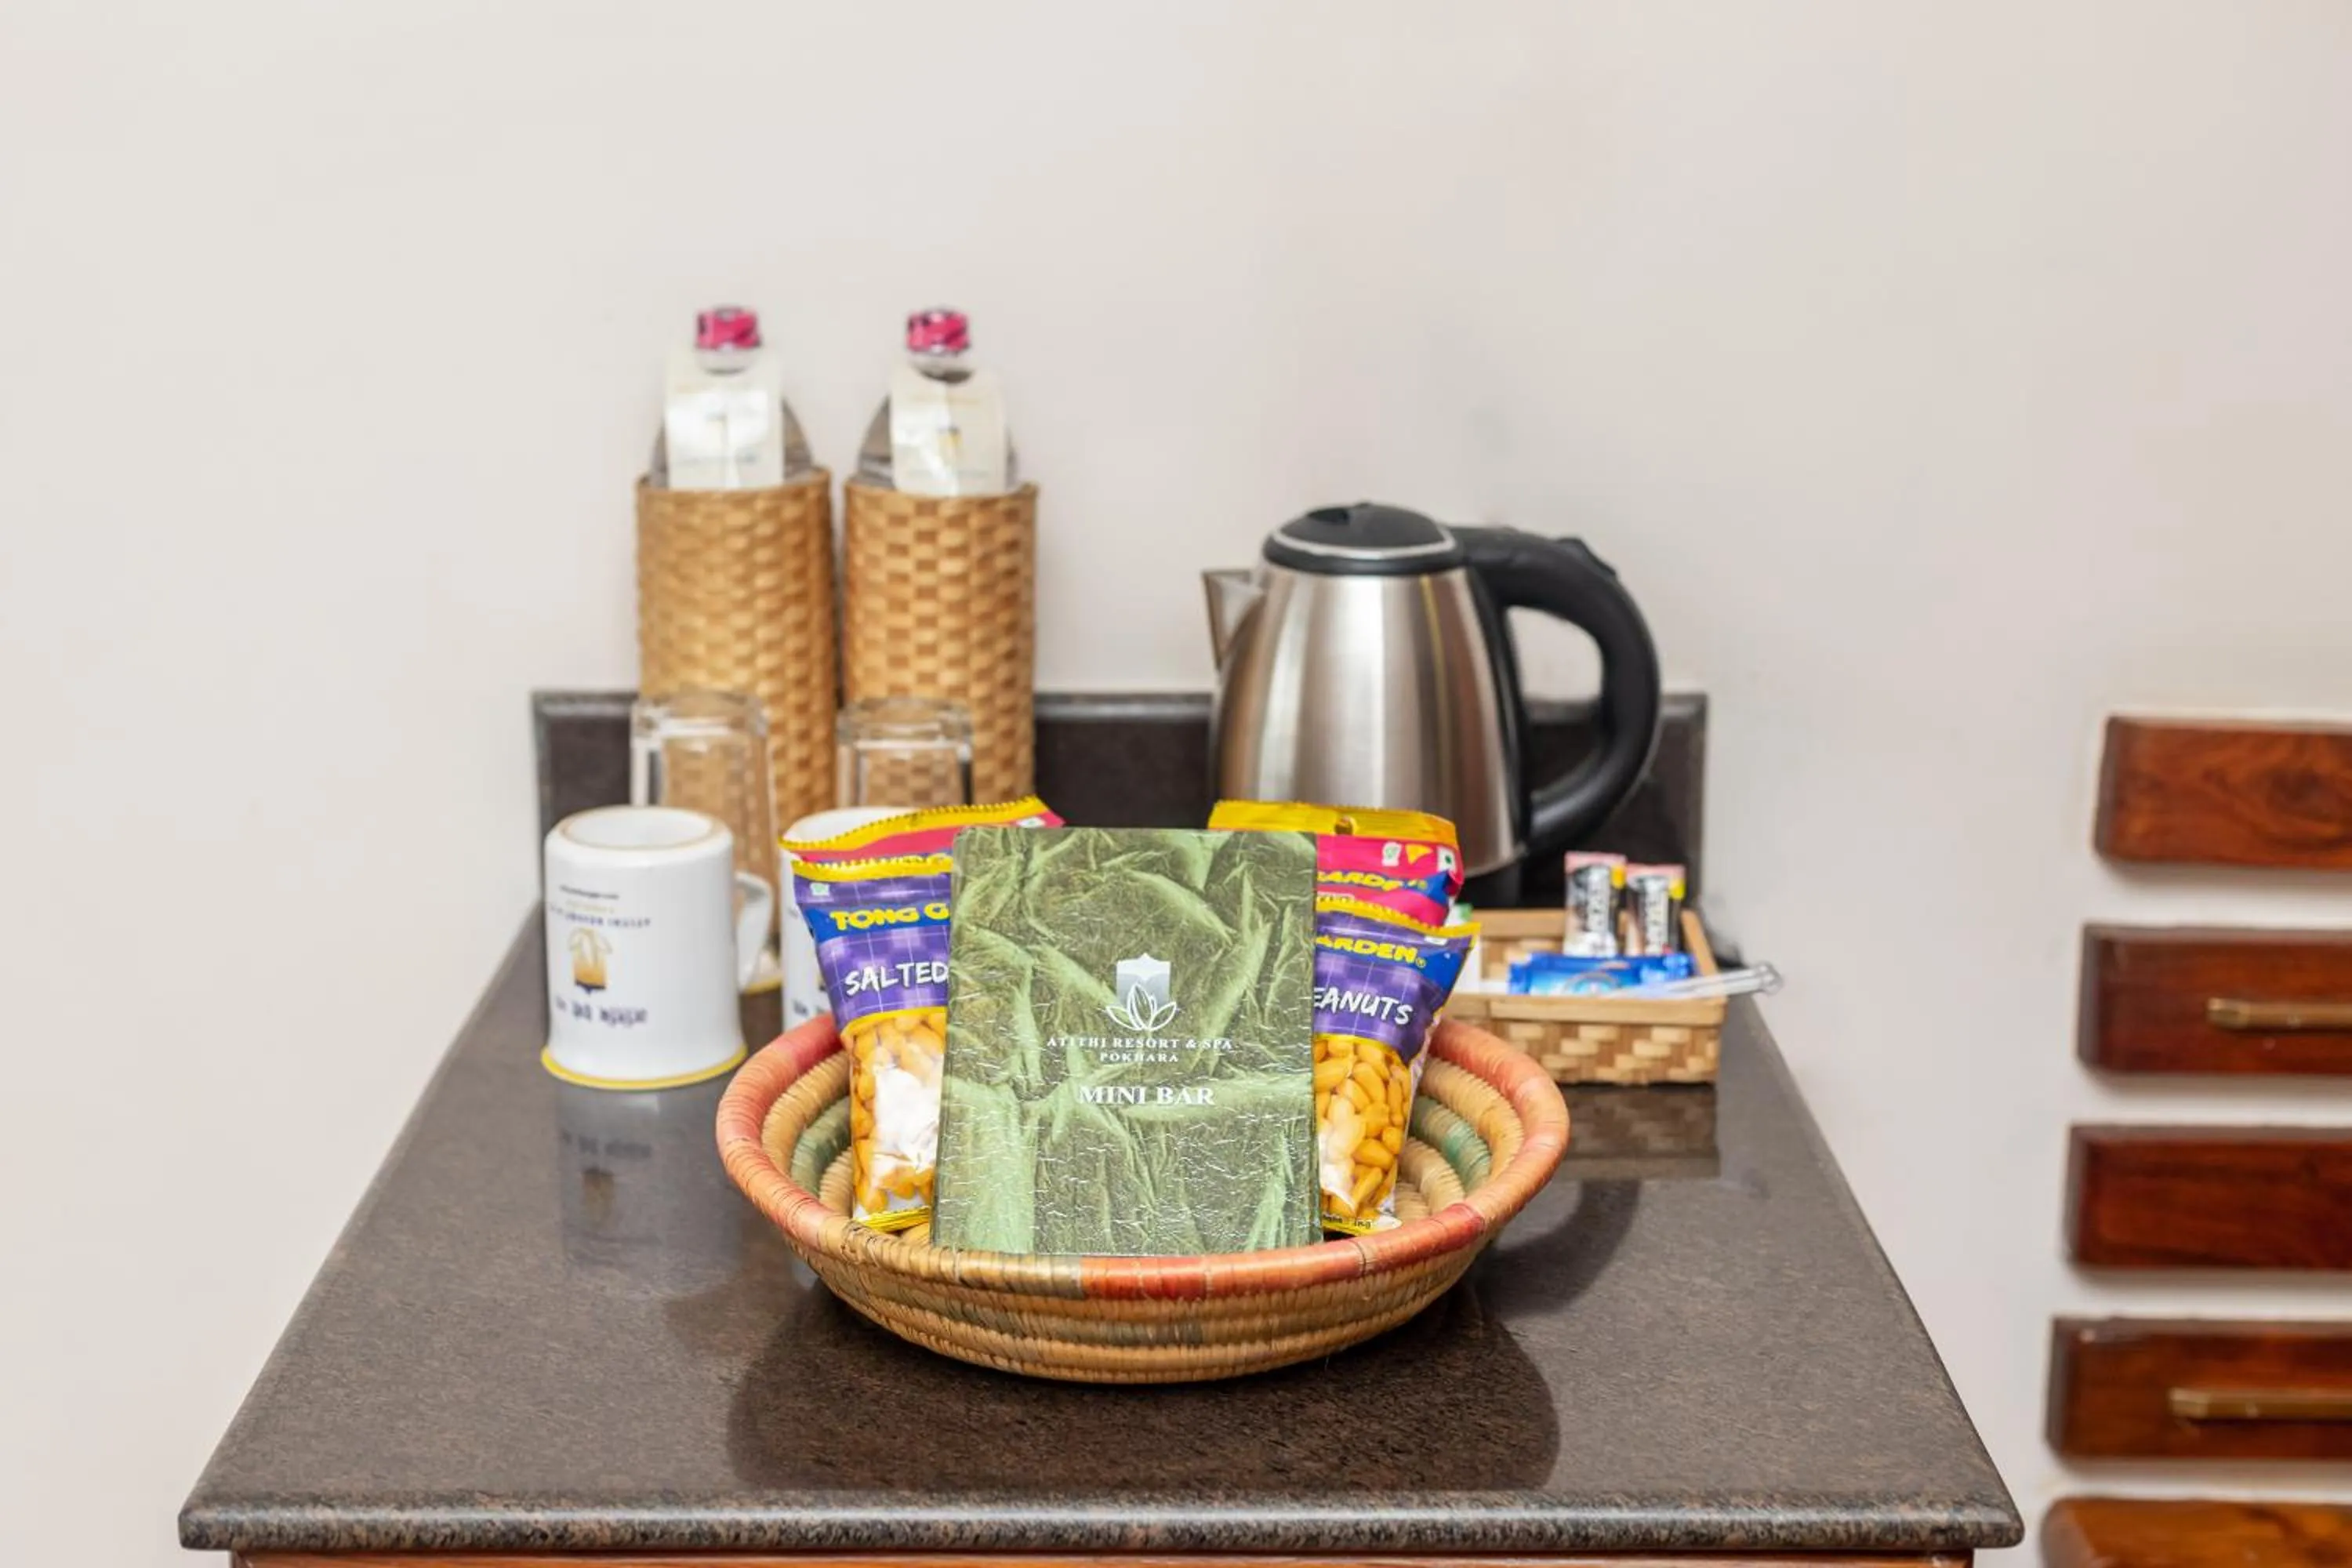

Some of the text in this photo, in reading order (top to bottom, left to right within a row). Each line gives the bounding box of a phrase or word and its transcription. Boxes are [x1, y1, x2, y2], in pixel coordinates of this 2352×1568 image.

[830, 906, 920, 931] TONG
[1316, 935, 1418, 964] ARDEN
[844, 961, 949, 996] SALTED
[1314, 986, 1414, 1025] EANUTS
[1046, 1036, 1233, 1050] ATITHI RESORT & SPA
[1099, 1052, 1179, 1063] POKHARA
[1078, 1085, 1215, 1105] MINI BAR
